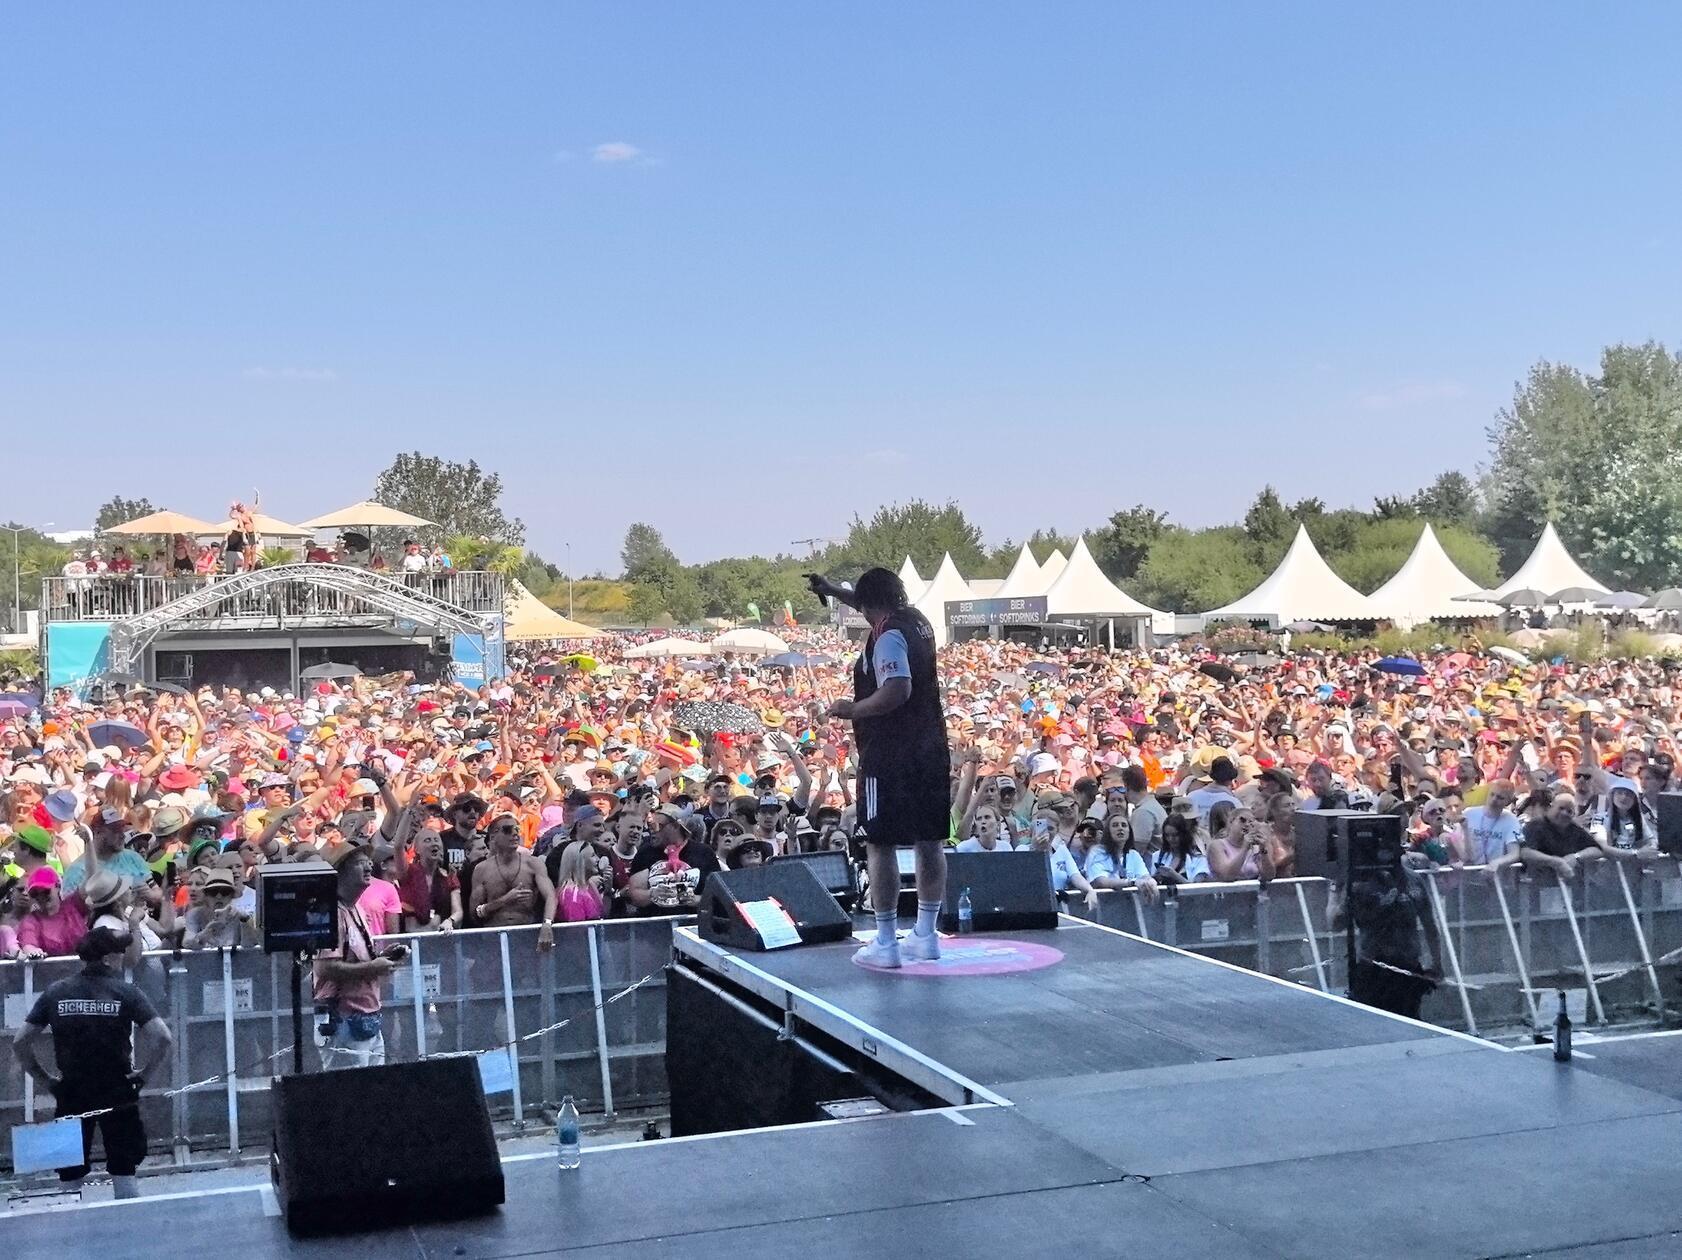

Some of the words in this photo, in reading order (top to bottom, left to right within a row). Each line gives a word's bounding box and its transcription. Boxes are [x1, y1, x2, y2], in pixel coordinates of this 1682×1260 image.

[960, 602, 974, 612] BIER
[1010, 600, 1025, 610] BIER
[950, 614, 986, 625] SOFTDRINKS
[999, 612, 1040, 624] SOFTDRINKS
[58, 1002, 121, 1014] SICHERHEIT
